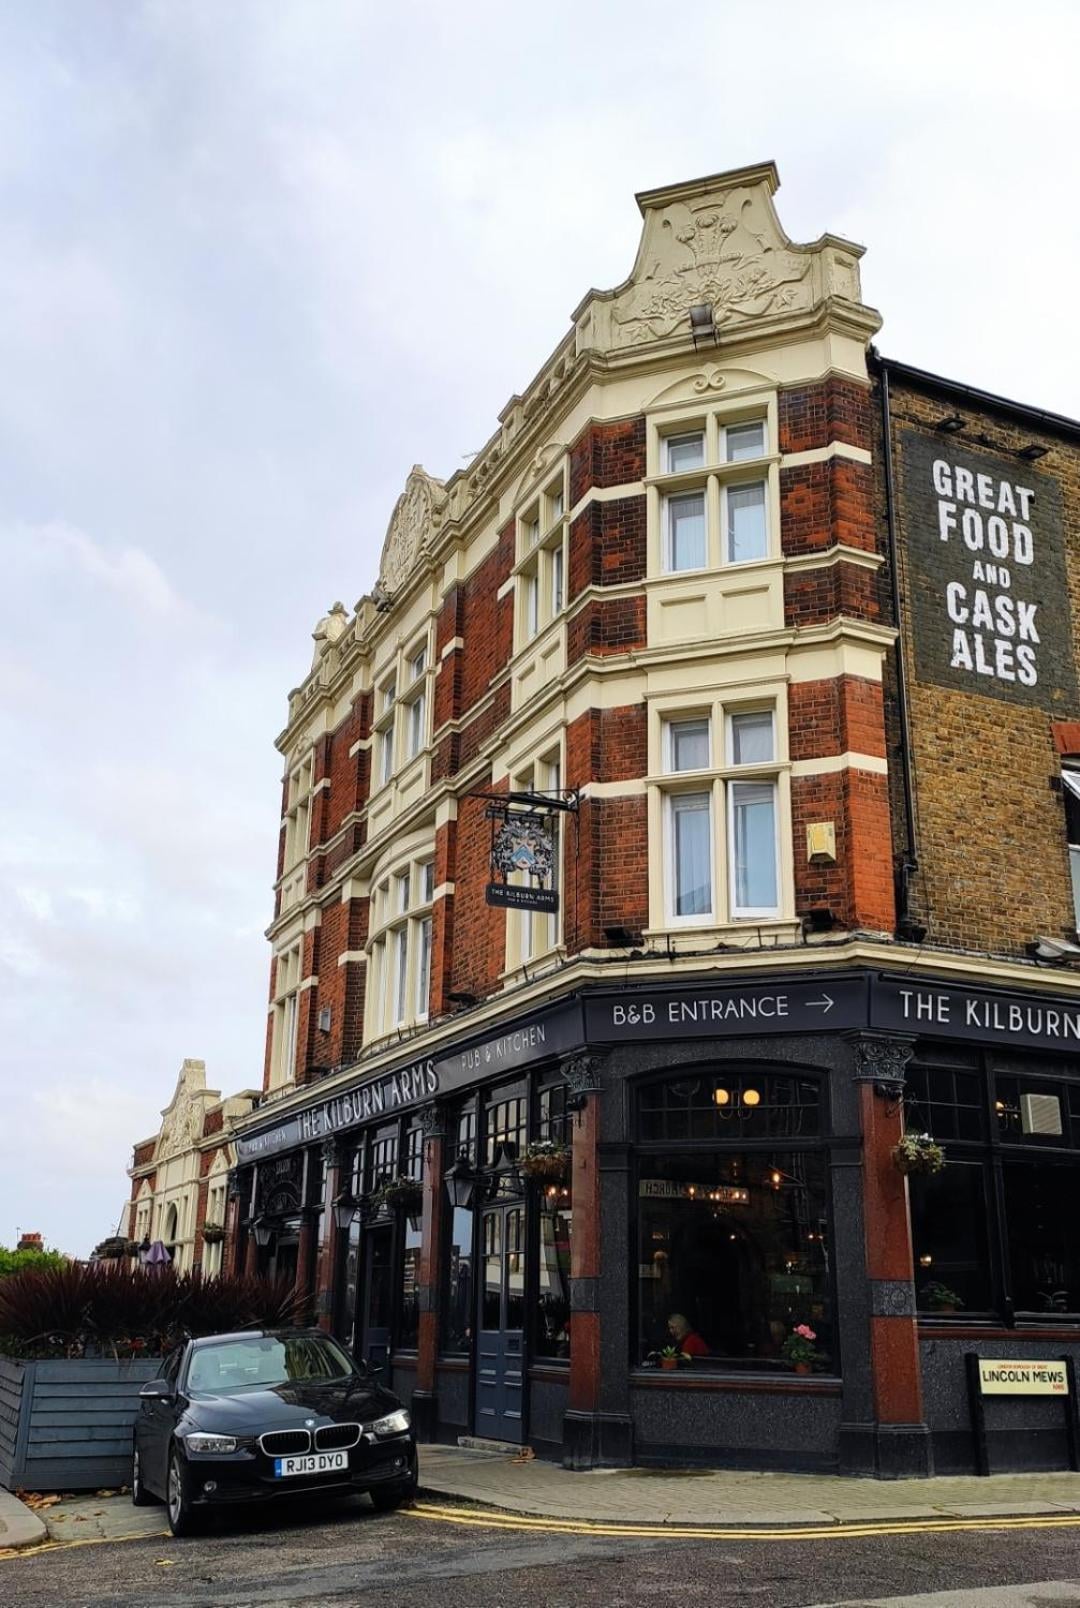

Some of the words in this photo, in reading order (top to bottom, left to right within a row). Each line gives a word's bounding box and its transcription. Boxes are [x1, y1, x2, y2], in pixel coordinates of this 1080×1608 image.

[932, 459, 1034, 521] GREAT
[938, 500, 1034, 566] FOOD
[972, 560, 1011, 589] AND
[946, 581, 1041, 643] CASK
[950, 628, 1038, 687] ALES
[491, 888, 504, 896] THE
[536, 894, 554, 903] ARMS
[613, 1003, 656, 1025] B&B
[668, 996, 789, 1022] ENTRANCE
[899, 990, 950, 1023] THE
[966, 999, 1080, 1040] KILBURN
[461, 1050, 480, 1070] PUB
[496, 1024, 546, 1058] KITCHEN
[296, 1109, 320, 1139] THE
[323, 1082, 384, 1131] KILBURN
[391, 1060, 438, 1106] ARMS
[982, 1370, 1030, 1382] LINCOLN
[1033, 1371, 1064, 1383] MEWS
[286, 1458, 316, 1473] RJ13
[319, 1454, 343, 1470] DYO
